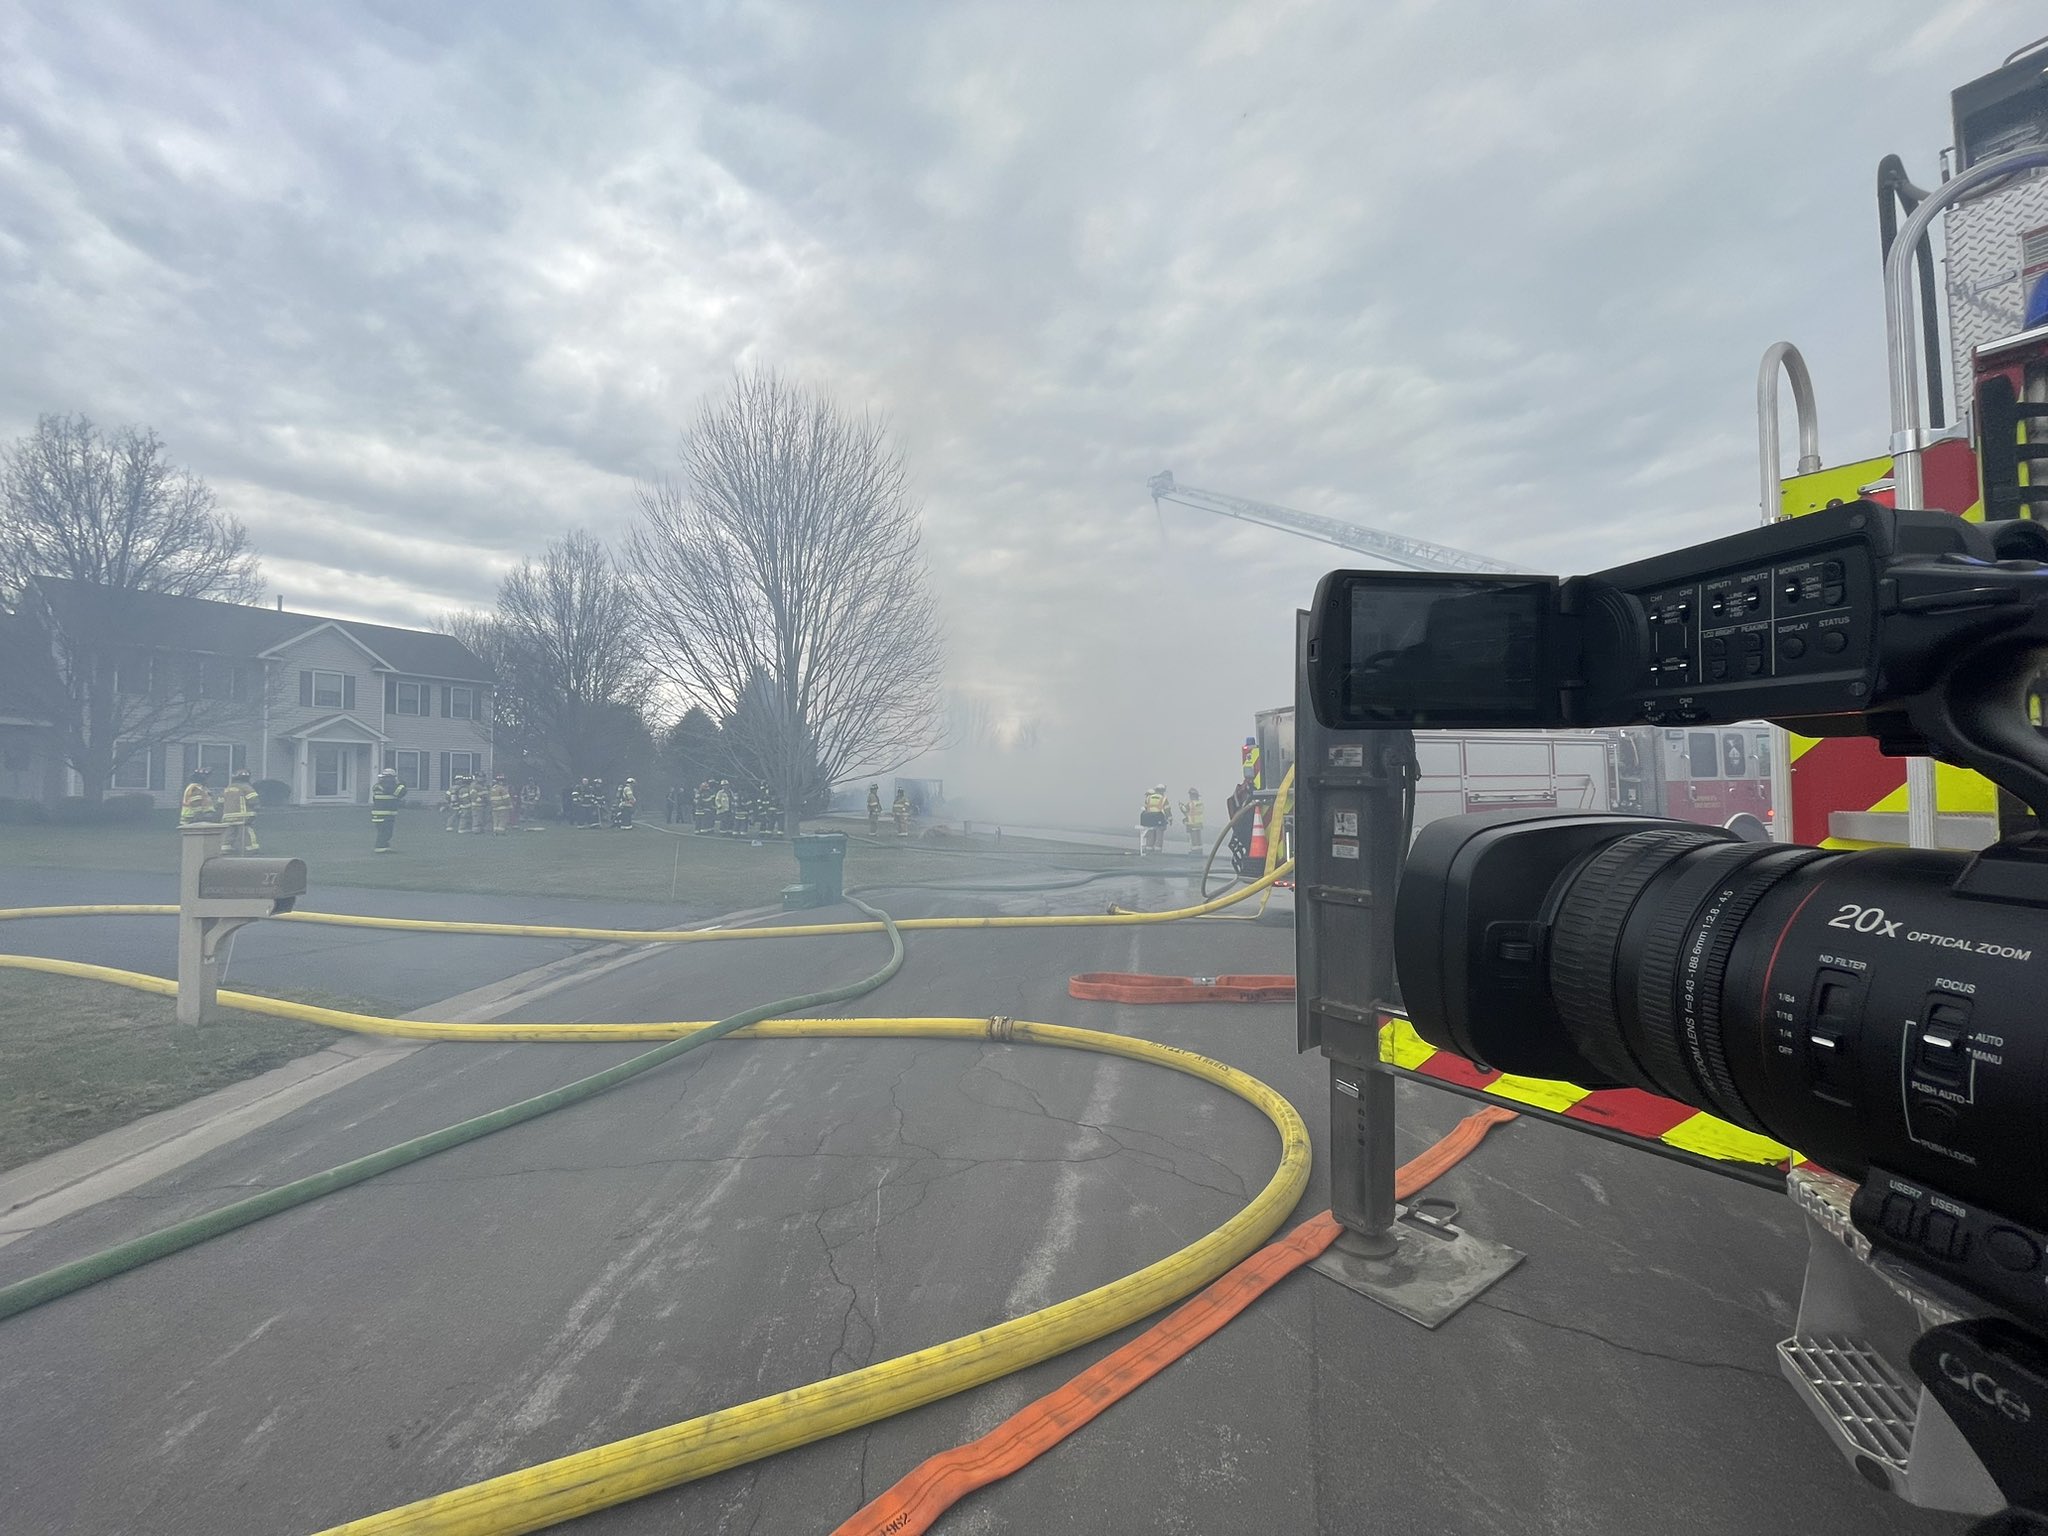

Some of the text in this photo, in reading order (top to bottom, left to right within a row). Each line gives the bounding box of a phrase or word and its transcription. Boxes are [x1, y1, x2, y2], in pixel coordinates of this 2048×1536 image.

[1778, 562, 1810, 575] MONITOR
[1741, 572, 1768, 584] INPUT2
[1707, 580, 1732, 590] INPUT1
[1741, 622, 1768, 633] PEAKING
[1778, 622, 1809, 634] DISPLAY
[1819, 616, 1850, 628] STATUS
[1714, 627, 1736, 638] BRIGHT
[262, 872, 278, 884] 27
[1828, 903, 2032, 962] 20x OPTICAL ZOOM
[1685, 1017, 1698, 1046] LENS
[1722, 889, 1734, 901] 4.5
[1818, 954, 1868, 972] ND FILTER
[1935, 977, 1976, 995] FOCUS
[1778, 992, 1795, 1004] 1/64
[1776, 1010, 1793, 1022] 1/16
[1779, 1028, 1792, 1038] 1/4
[1975, 1032, 2003, 1047] AUTO
[1778, 1045, 1793, 1055] OFF
[1972, 1049, 2002, 1066] MANU
[1911, 1080, 1965, 1104] PUSH AUTO
[1948, 1149, 1977, 1168] LOCK
[1889, 1179, 1923, 1199] USER7
[1930, 1196, 1967, 1218] USER8
